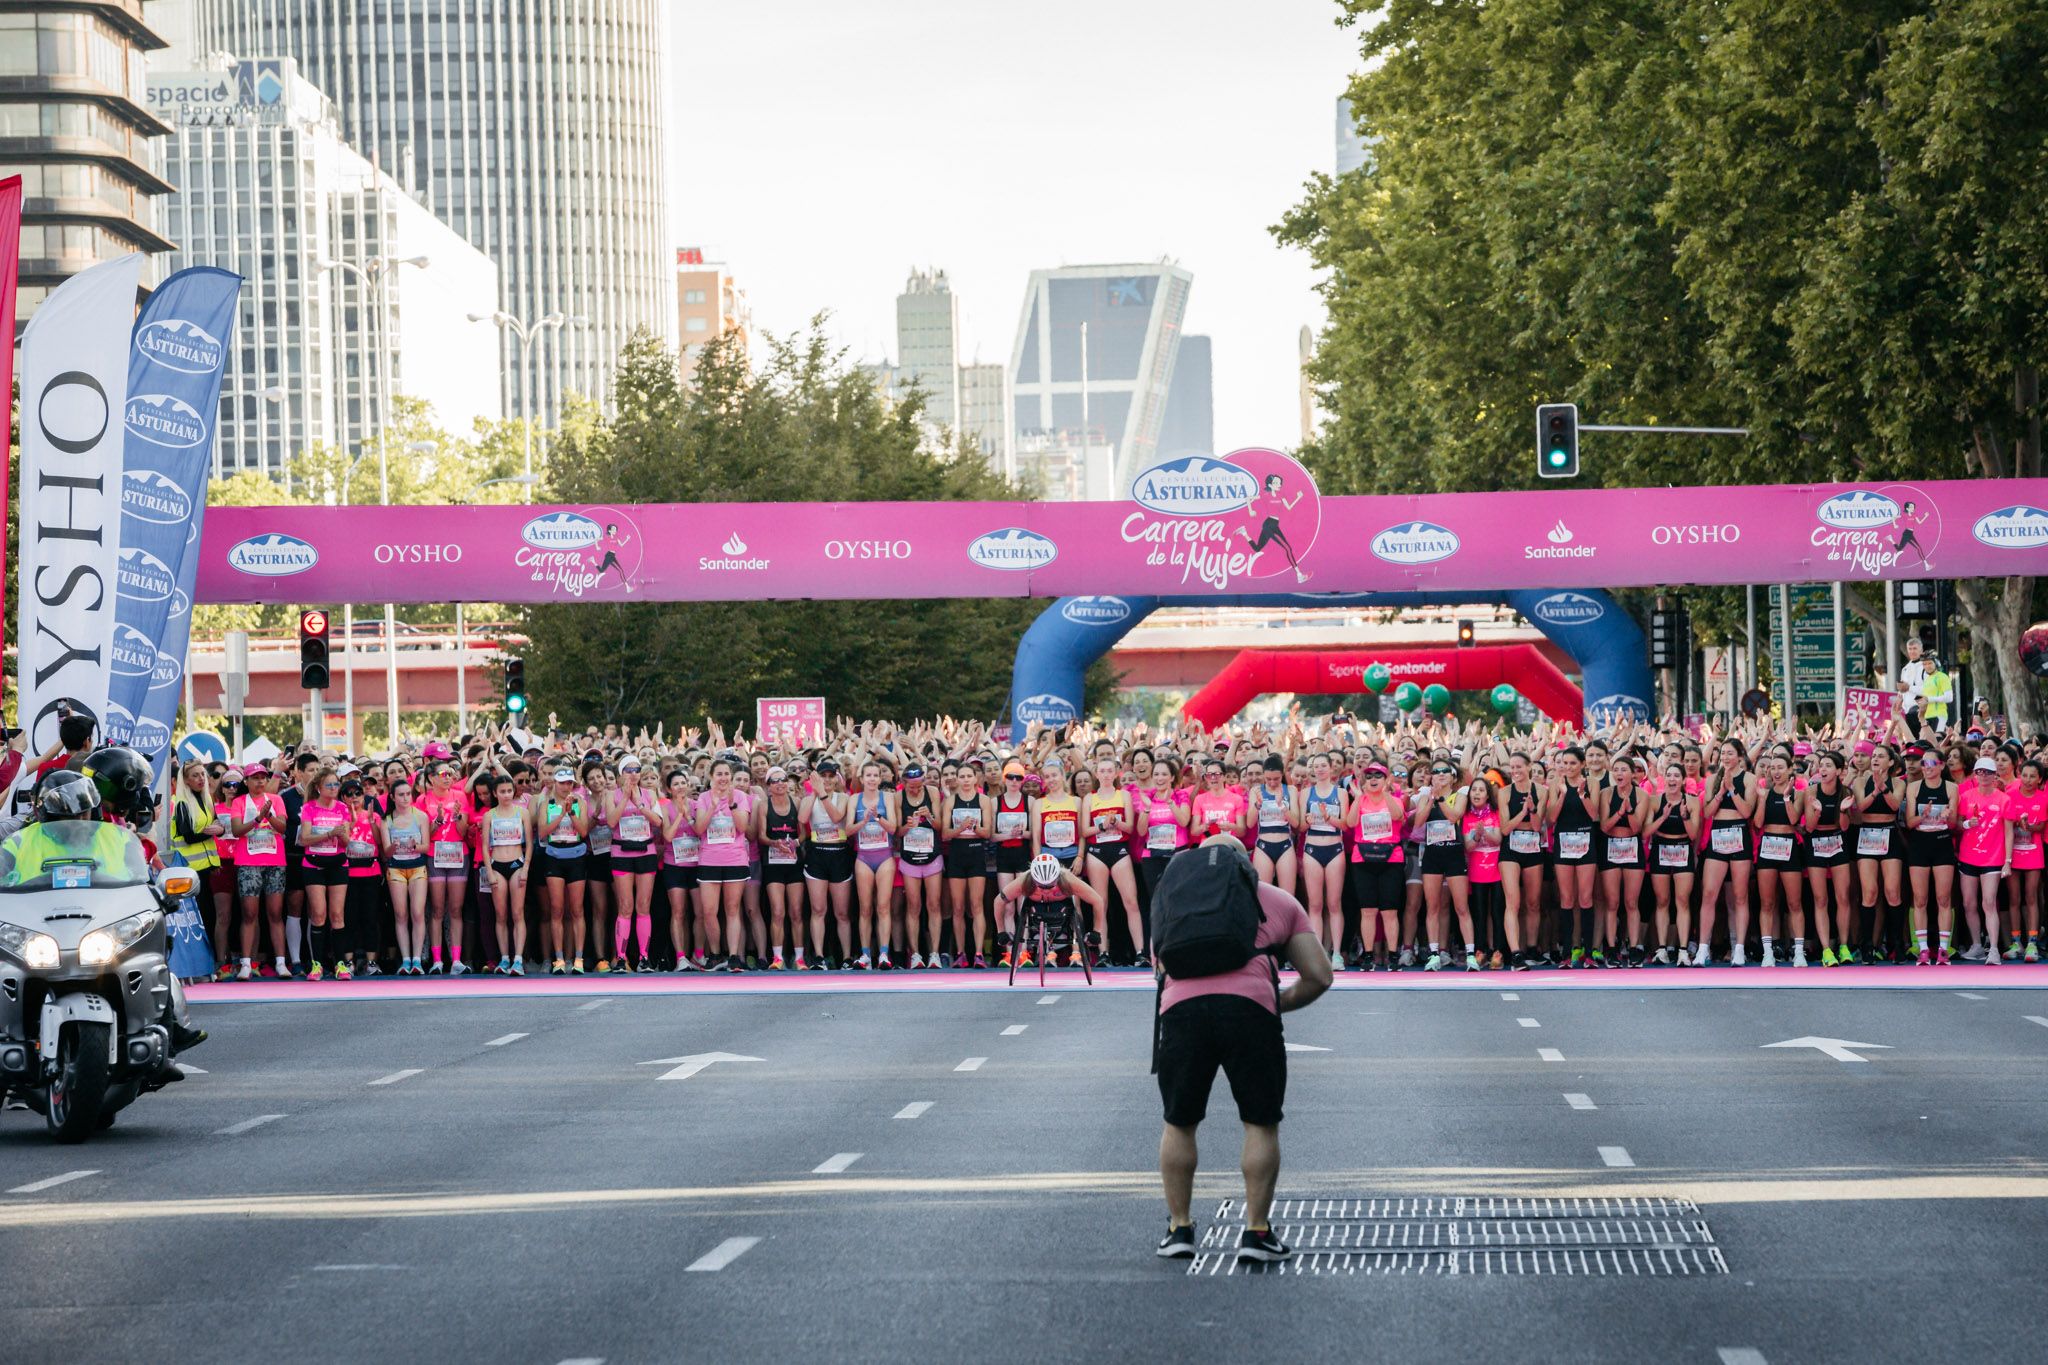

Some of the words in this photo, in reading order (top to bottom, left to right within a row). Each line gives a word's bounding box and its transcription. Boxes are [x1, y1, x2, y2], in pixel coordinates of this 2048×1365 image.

[142, 330, 217, 367] ASTURIANA
[124, 405, 198, 441] ASTURIANA
[1203, 475, 1245, 483] LECHERA
[1142, 478, 1248, 501] ASTURIANA
[1824, 505, 1894, 519] ASTURIANA
[529, 526, 596, 540] ASTURIANA
[1121, 512, 1226, 543] Carrera
[1651, 524, 1741, 545] OYSHO
[1810, 526, 1878, 547] Carrera
[374, 543, 462, 563] OYSHO
[824, 540, 912, 560] OYSHO
[976, 543, 1051, 559] ASTURIANA
[1378, 538, 1453, 554] ASTURIANA
[1524, 544, 1597, 559] Santander
[32, 370, 109, 758] OYSHO
[236, 548, 311, 565] ASTURIANA
[515, 546, 582, 567] Carrera
[699, 557, 771, 571] Santander
[1146, 543, 1166, 565] de
[1170, 543, 1184, 565] la
[1181, 538, 1265, 590] Mujer
[1828, 547, 1840, 561] de
[1842, 546, 1852, 561] la
[1850, 543, 1904, 576] Mujer
[531, 567, 544, 581] de
[545, 565, 556, 581] la
[553, 564, 606, 597] Mujer
[1068, 603, 1125, 617] ASTURIANA
[1540, 605, 1599, 617] ASTURIANA
[1795, 618, 1835, 627] Argentin
[1848, 691, 1879, 707] SUB
[768, 704, 798, 718] SUB
